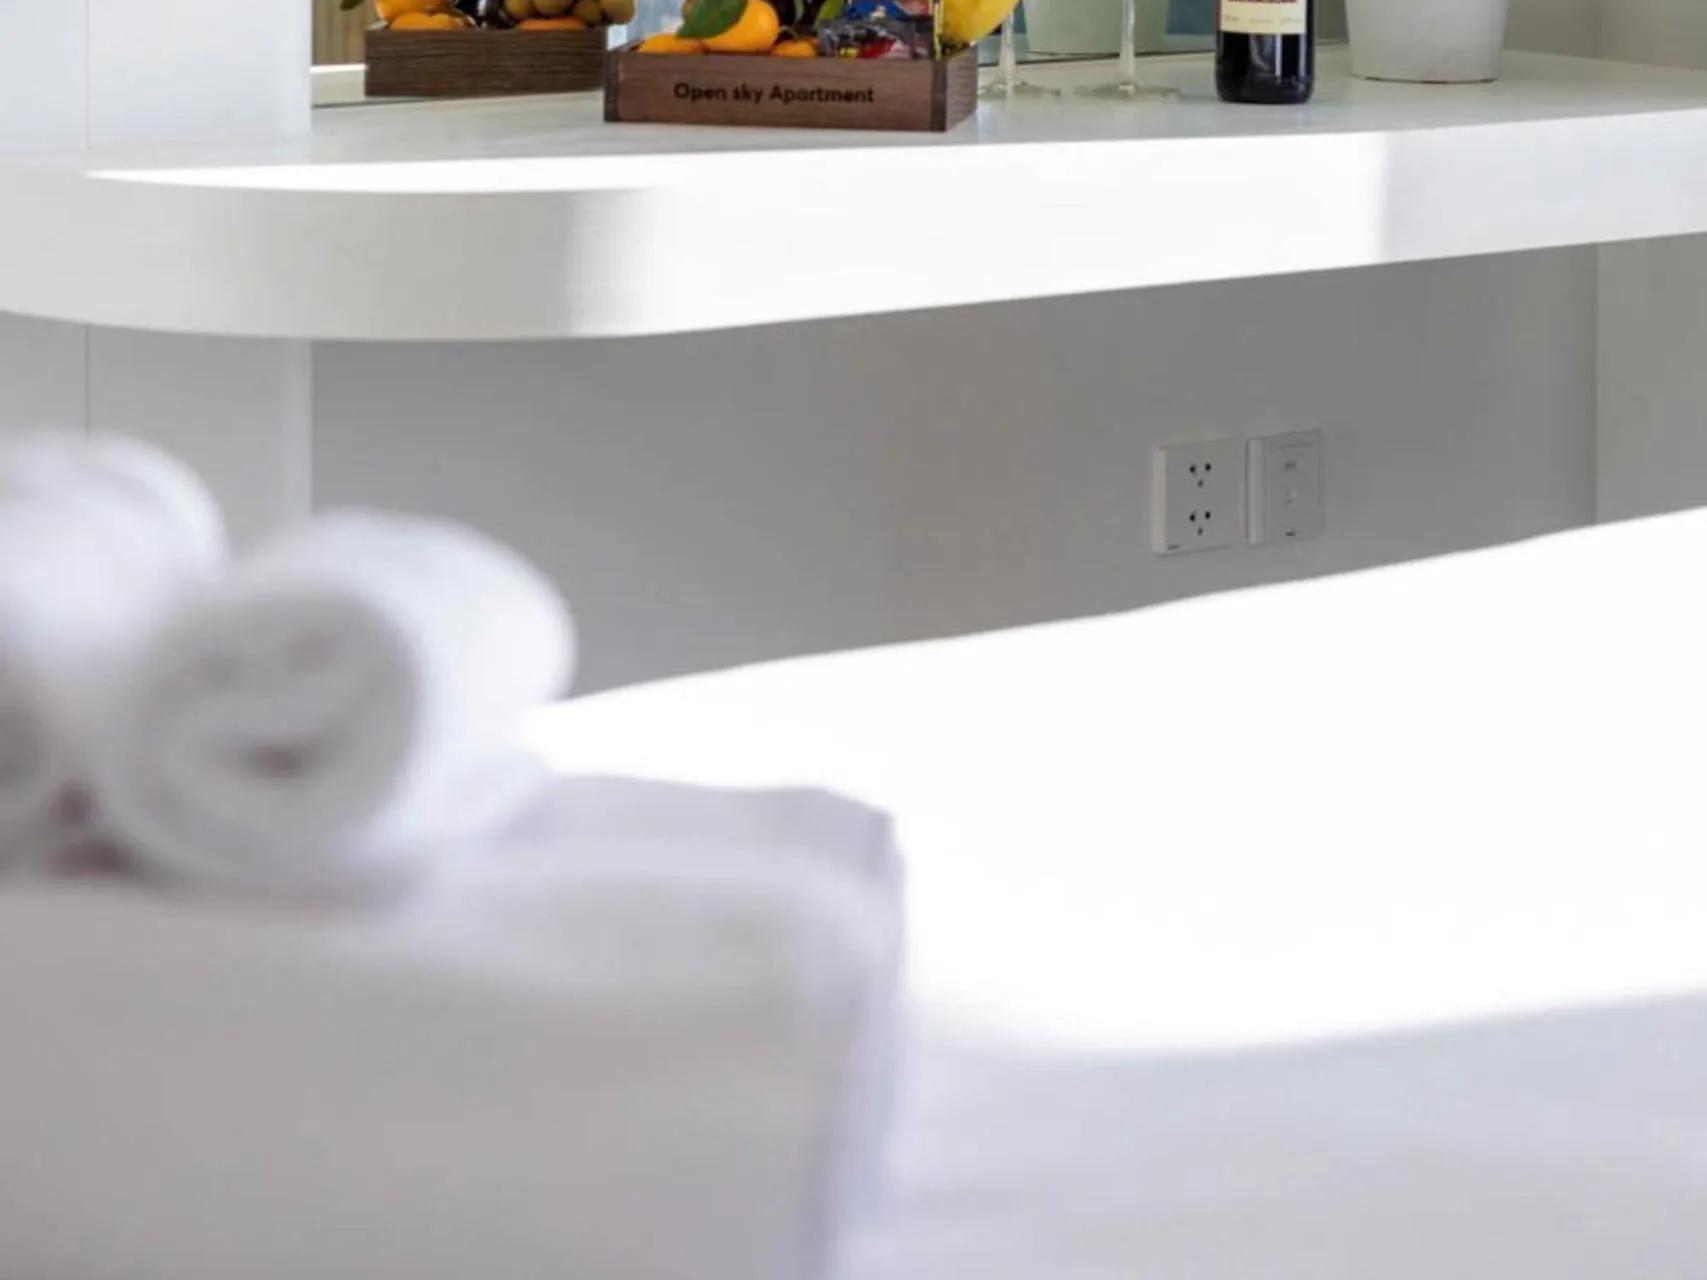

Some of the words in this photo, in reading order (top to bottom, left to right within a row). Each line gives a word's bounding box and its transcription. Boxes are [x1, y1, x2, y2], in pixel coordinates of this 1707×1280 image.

[673, 82, 727, 103] Open
[732, 82, 764, 105] sky
[769, 84, 875, 106] Apartment
